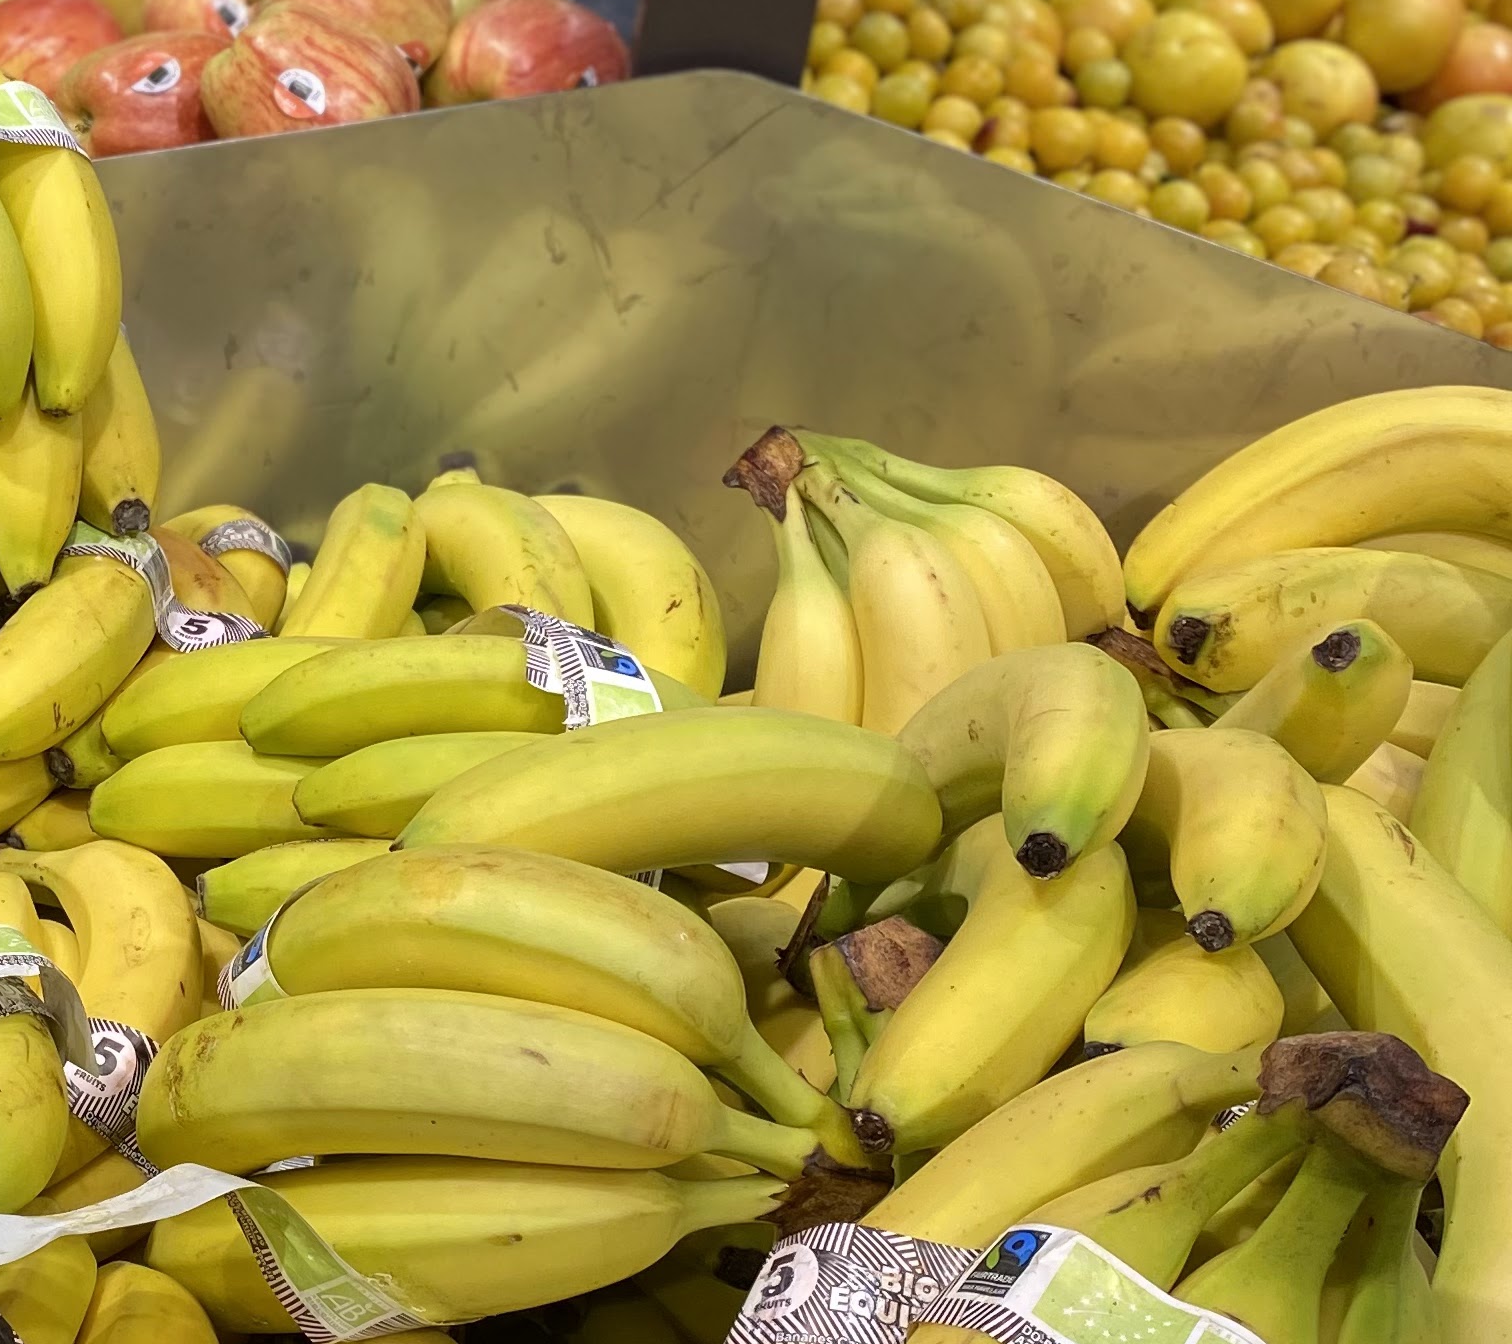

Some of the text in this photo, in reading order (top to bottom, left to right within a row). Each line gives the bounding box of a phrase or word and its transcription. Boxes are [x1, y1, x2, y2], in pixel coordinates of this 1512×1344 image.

[180, 617, 210, 636] 5
[94, 1037, 125, 1077] 5
[73, 1067, 108, 1093] FRUITS
[760, 1251, 798, 1298] 5
[880, 1265, 940, 1303] BIO
